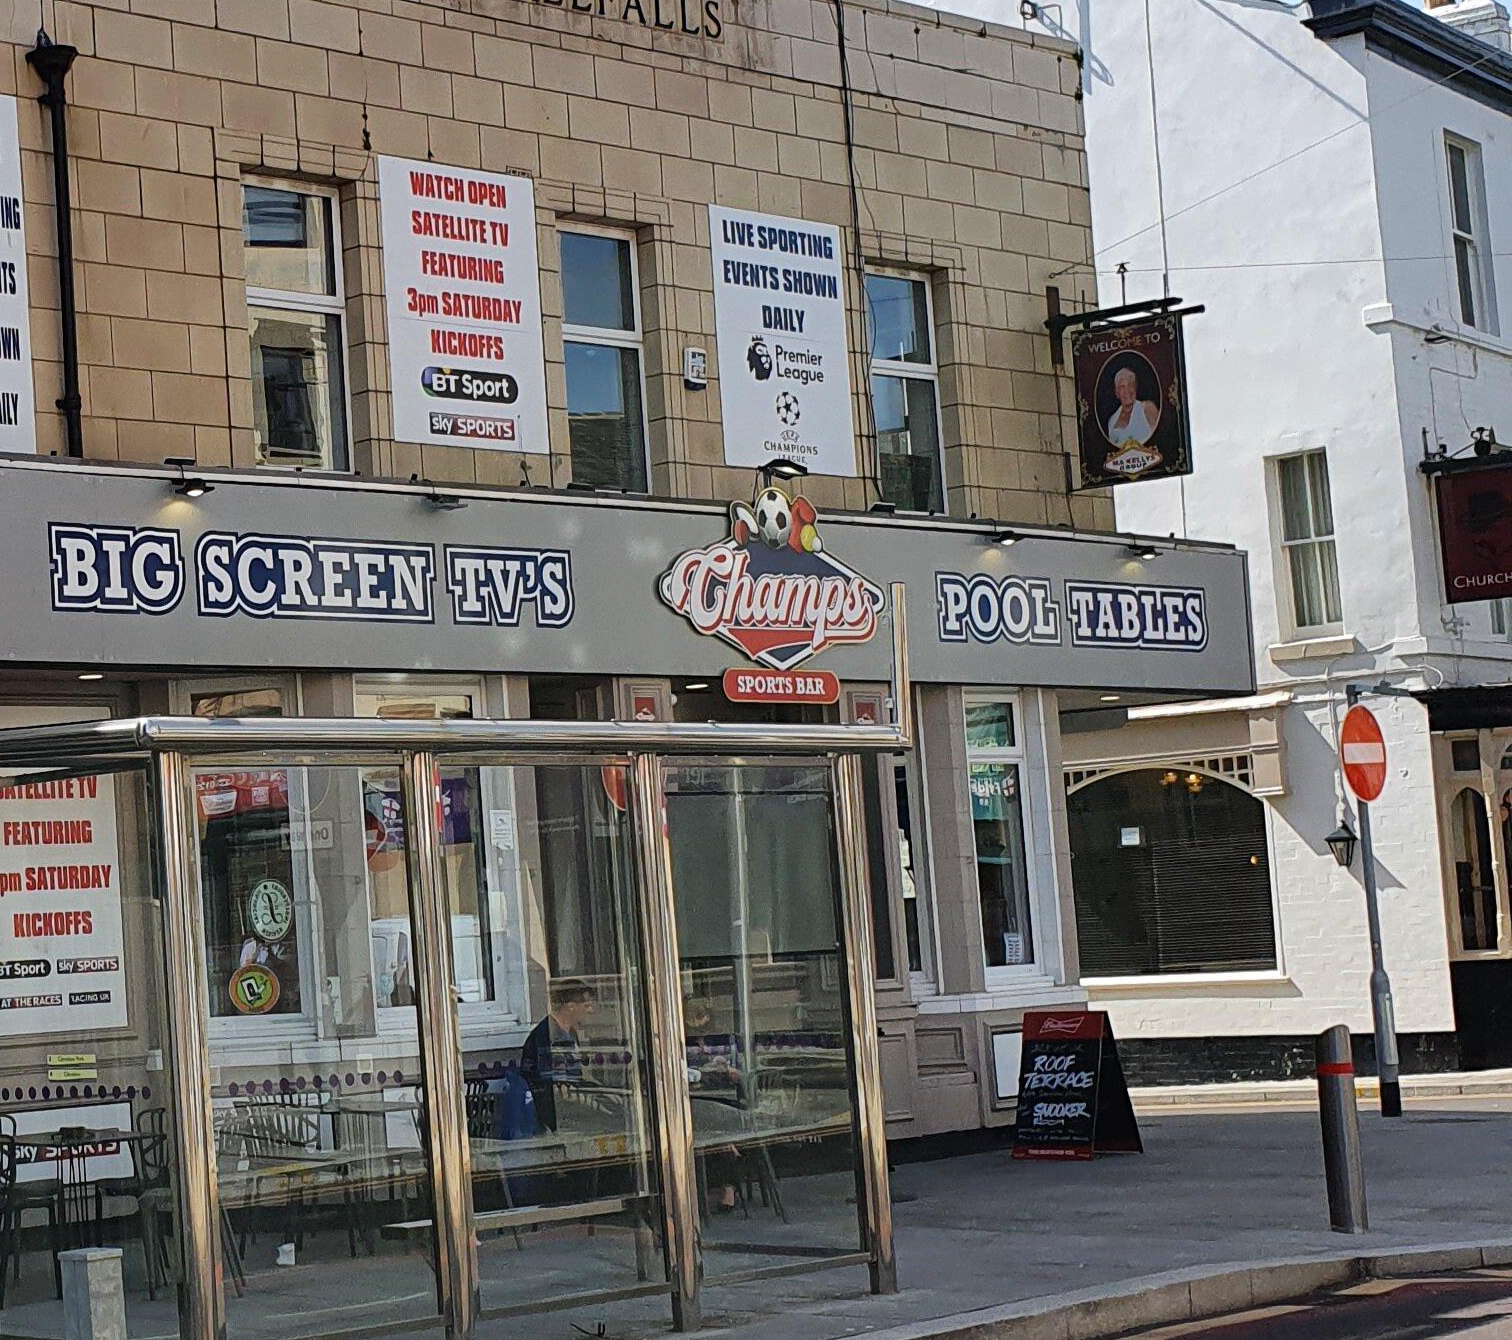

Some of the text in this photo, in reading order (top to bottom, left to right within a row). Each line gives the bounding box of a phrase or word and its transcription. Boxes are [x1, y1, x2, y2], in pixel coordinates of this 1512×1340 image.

[409, 171, 507, 209] WATCH OPEN
[411, 210, 509, 247] SATELLITE TV
[722, 219, 833, 260] LIVE SPORTING
[421, 250, 504, 284] FEATURING
[723, 260, 838, 300] EVENTS SHOWN
[407, 287, 522, 324] 3pm SATURDAY
[762, 305, 805, 333] DAILY
[430, 329, 504, 361] KICKOFFS
[775, 345, 823, 367] Premier
[1088, 332, 1161, 354] WELCOME TO
[431, 372, 510, 400] BT Sport
[776, 364, 824, 385] League
[431, 415, 513, 439] sky SPORTS
[763, 440, 819, 456] CHAMPIONS
[59, 536, 568, 617] BIG SCREEN TV'S
[1453, 572, 1512, 589] CHURCH
[670, 545, 878, 654] Champs
[941, 581, 1205, 643] POOL TABLES
[738, 675, 826, 695] SPORTS BAR
[77, 775, 98, 799] TV
[3, 820, 93, 846] FEATURING
[25, 864, 112, 892] SATURDAY
[13, 911, 93, 938] KICKOFFS
[14, 962, 45, 976] Sport
[58, 958, 118, 973] sky SPORTS
[1, 998, 12, 1008] AT
[1033, 1054, 1076, 1072] ROOF
[1023, 1072, 1095, 1090] TERRACE
[1033, 1102, 1091, 1118] SNOOKER
